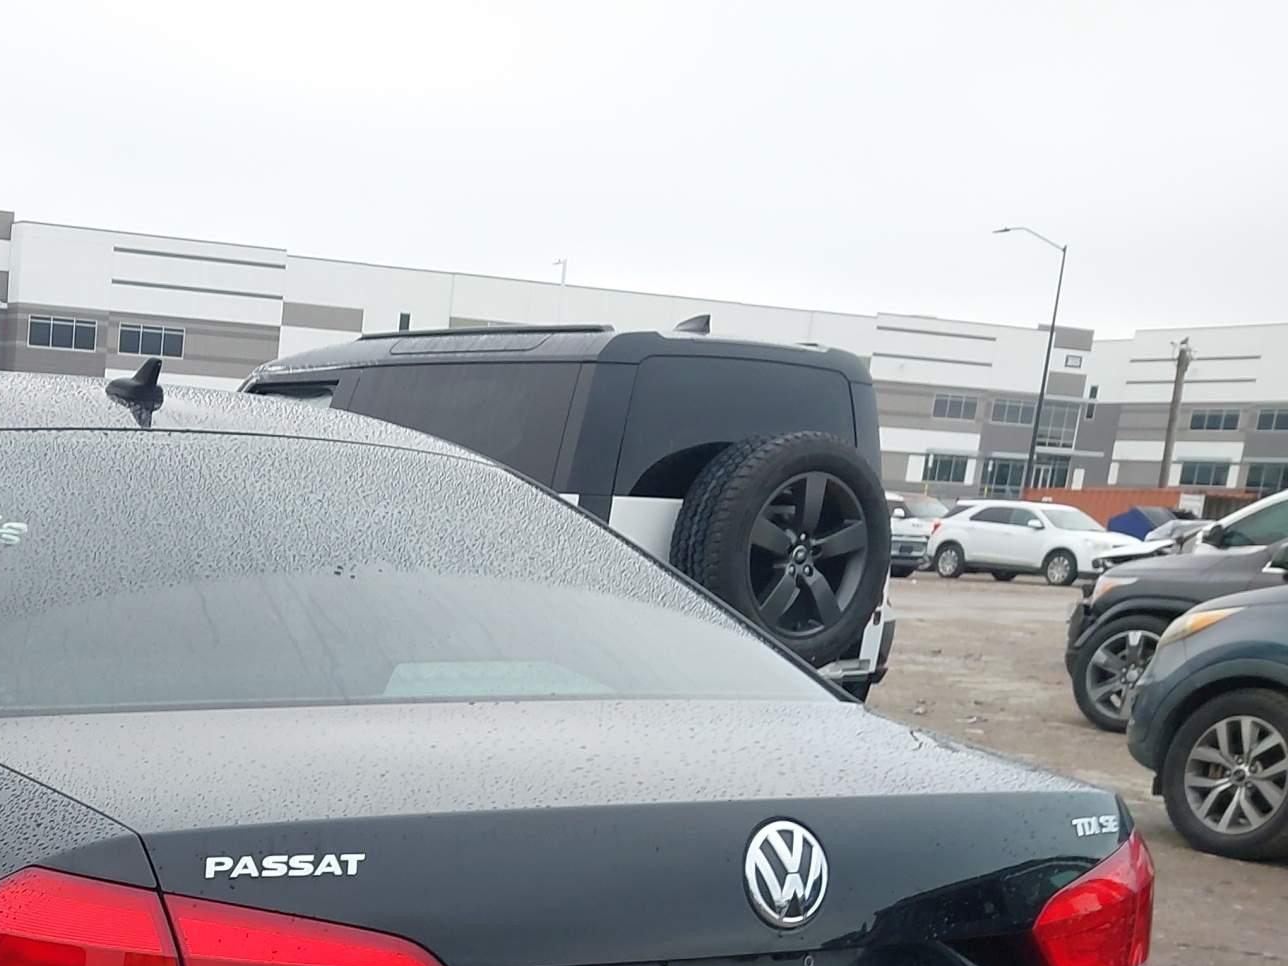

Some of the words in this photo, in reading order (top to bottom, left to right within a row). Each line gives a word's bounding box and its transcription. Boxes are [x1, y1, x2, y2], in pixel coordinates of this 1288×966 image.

[1071, 816, 1100, 837] TDI
[204, 853, 366, 879] PASSAT
[747, 820, 825, 926] VW
